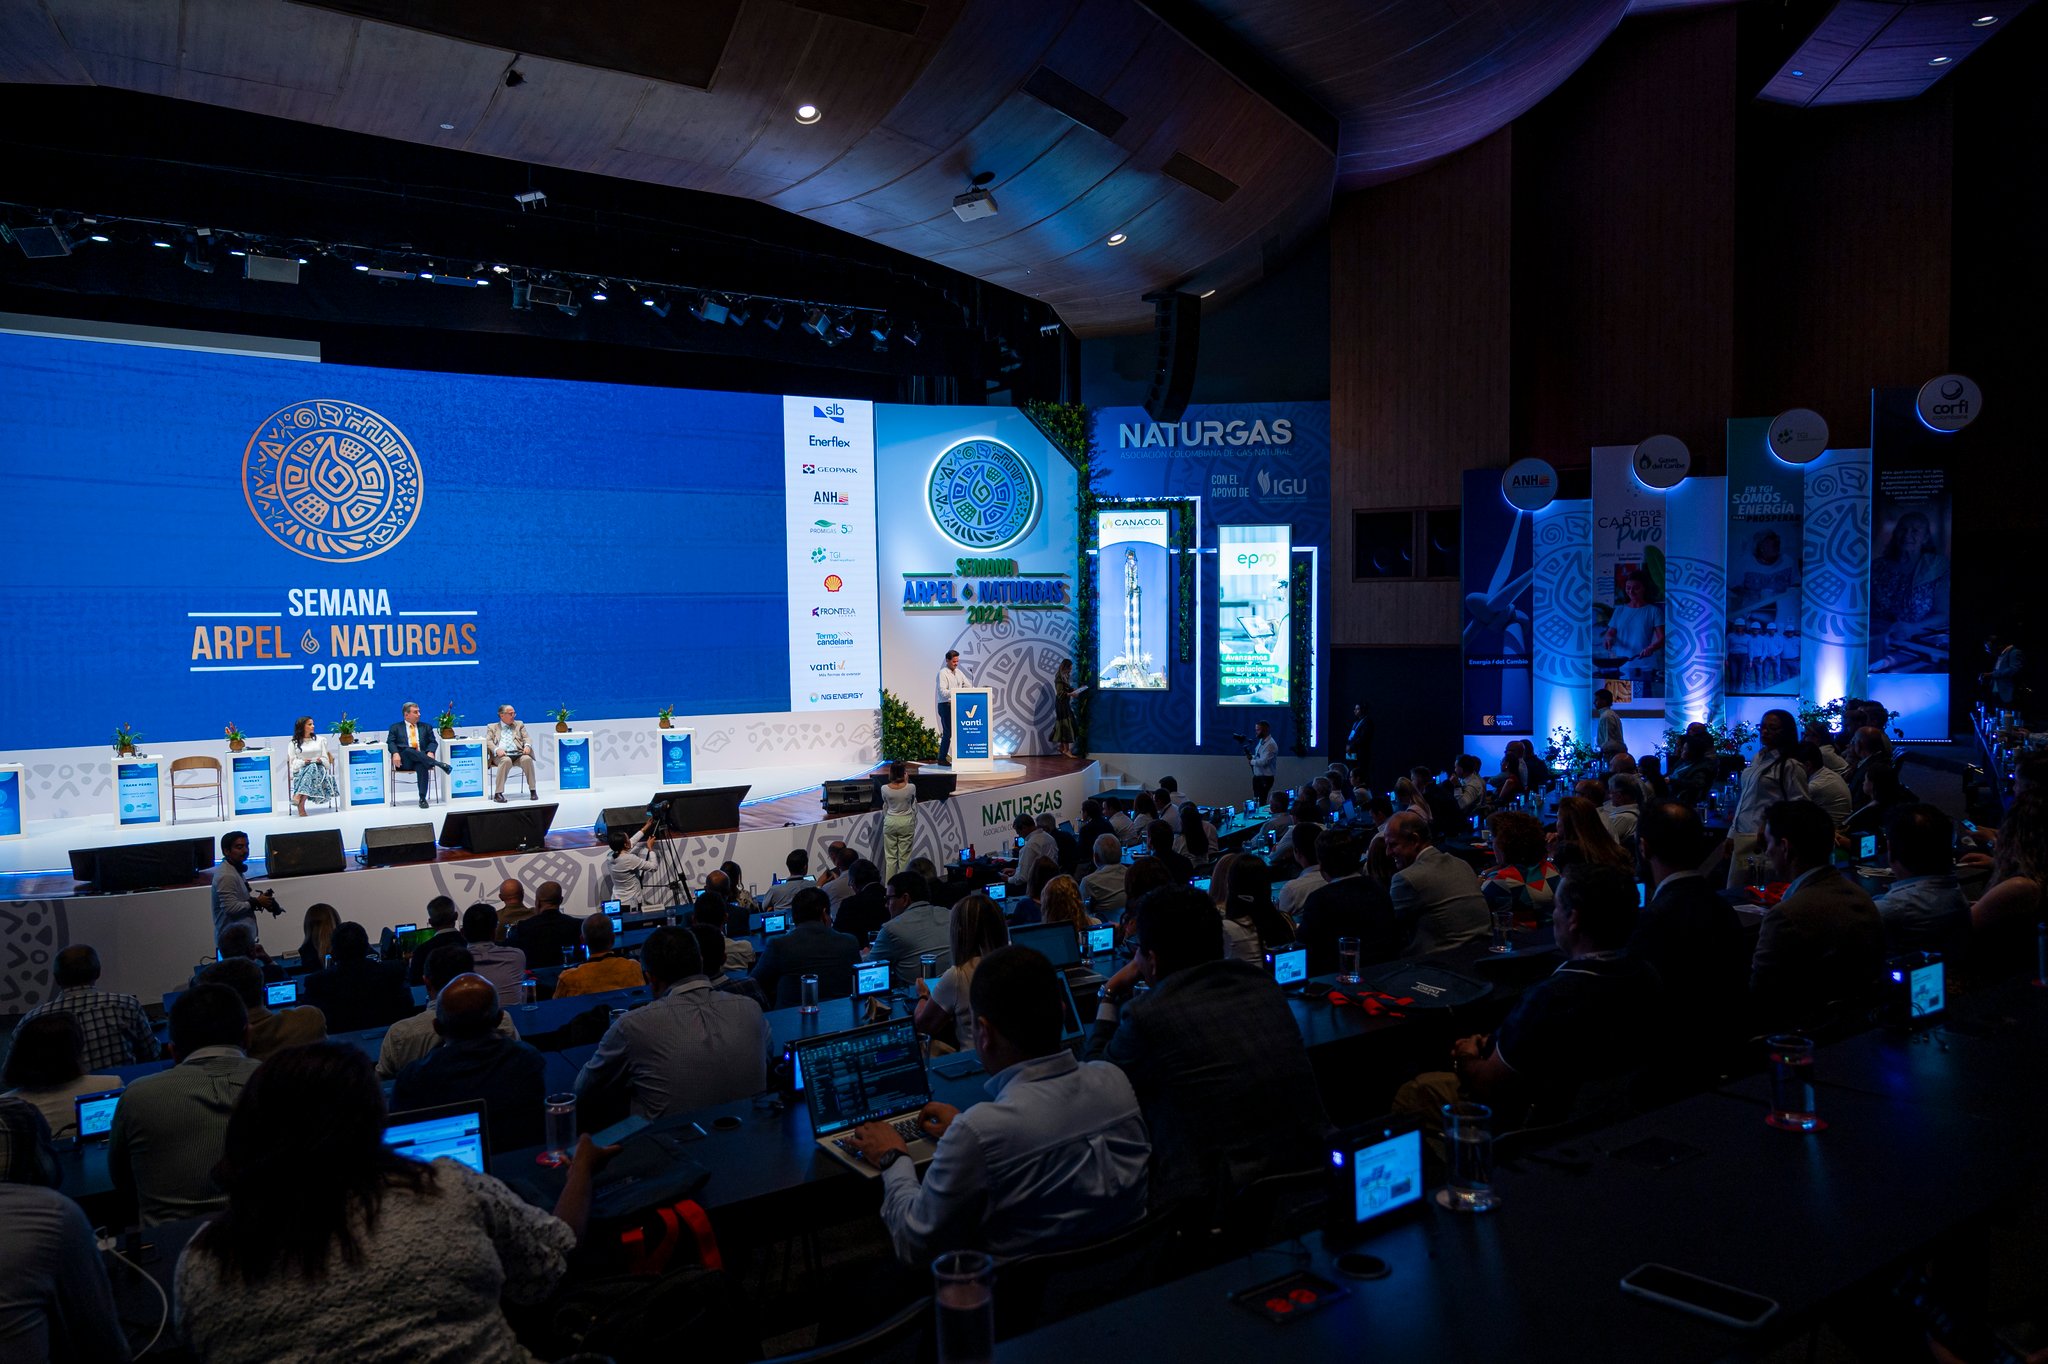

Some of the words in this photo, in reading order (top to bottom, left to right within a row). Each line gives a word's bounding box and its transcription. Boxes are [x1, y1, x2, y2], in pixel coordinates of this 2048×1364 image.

[825, 403, 844, 416] slb
[1933, 400, 1968, 414] corfi
[1120, 419, 1293, 448] NATURGAS
[809, 435, 850, 448] Enerflex
[1223, 449, 1235, 457] DE
[1237, 448, 1253, 457] GAS
[1254, 447, 1293, 456] NATURAL
[817, 466, 858, 474] GEOPARK
[1211, 474, 1227, 485] CON
[1229, 474, 1239, 485] EL
[1512, 474, 1538, 486] ANH
[1211, 487, 1237, 498] APOYO
[1239, 487, 1249, 497] DE
[1273, 479, 1307, 495] IGU
[1758, 485, 1773, 493] TGI
[813, 491, 838, 502] ANH
[1731, 492, 1781, 504] SOMOS
[1738, 500, 1795, 515] ENERGÍA
[1114, 518, 1163, 526] CANACOL
[1598, 516, 1661, 528] CARIBE
[1237, 553, 1276, 568] epm
[956, 558, 1014, 577] SEMANA
[903, 580, 957, 603] ARPEL
[979, 580, 1065, 603] NATURGAS
[288, 588, 391, 617] SEMANA
[966, 604, 1004, 625] 2024
[191, 625, 292, 660] ARPEL
[331, 623, 477, 657] NATURGAS
[810, 661, 836, 671] vanti
[311, 662, 375, 691] 2024
[833, 692, 864, 700] ENERGY
[982, 789, 1063, 827] NATURGAS
